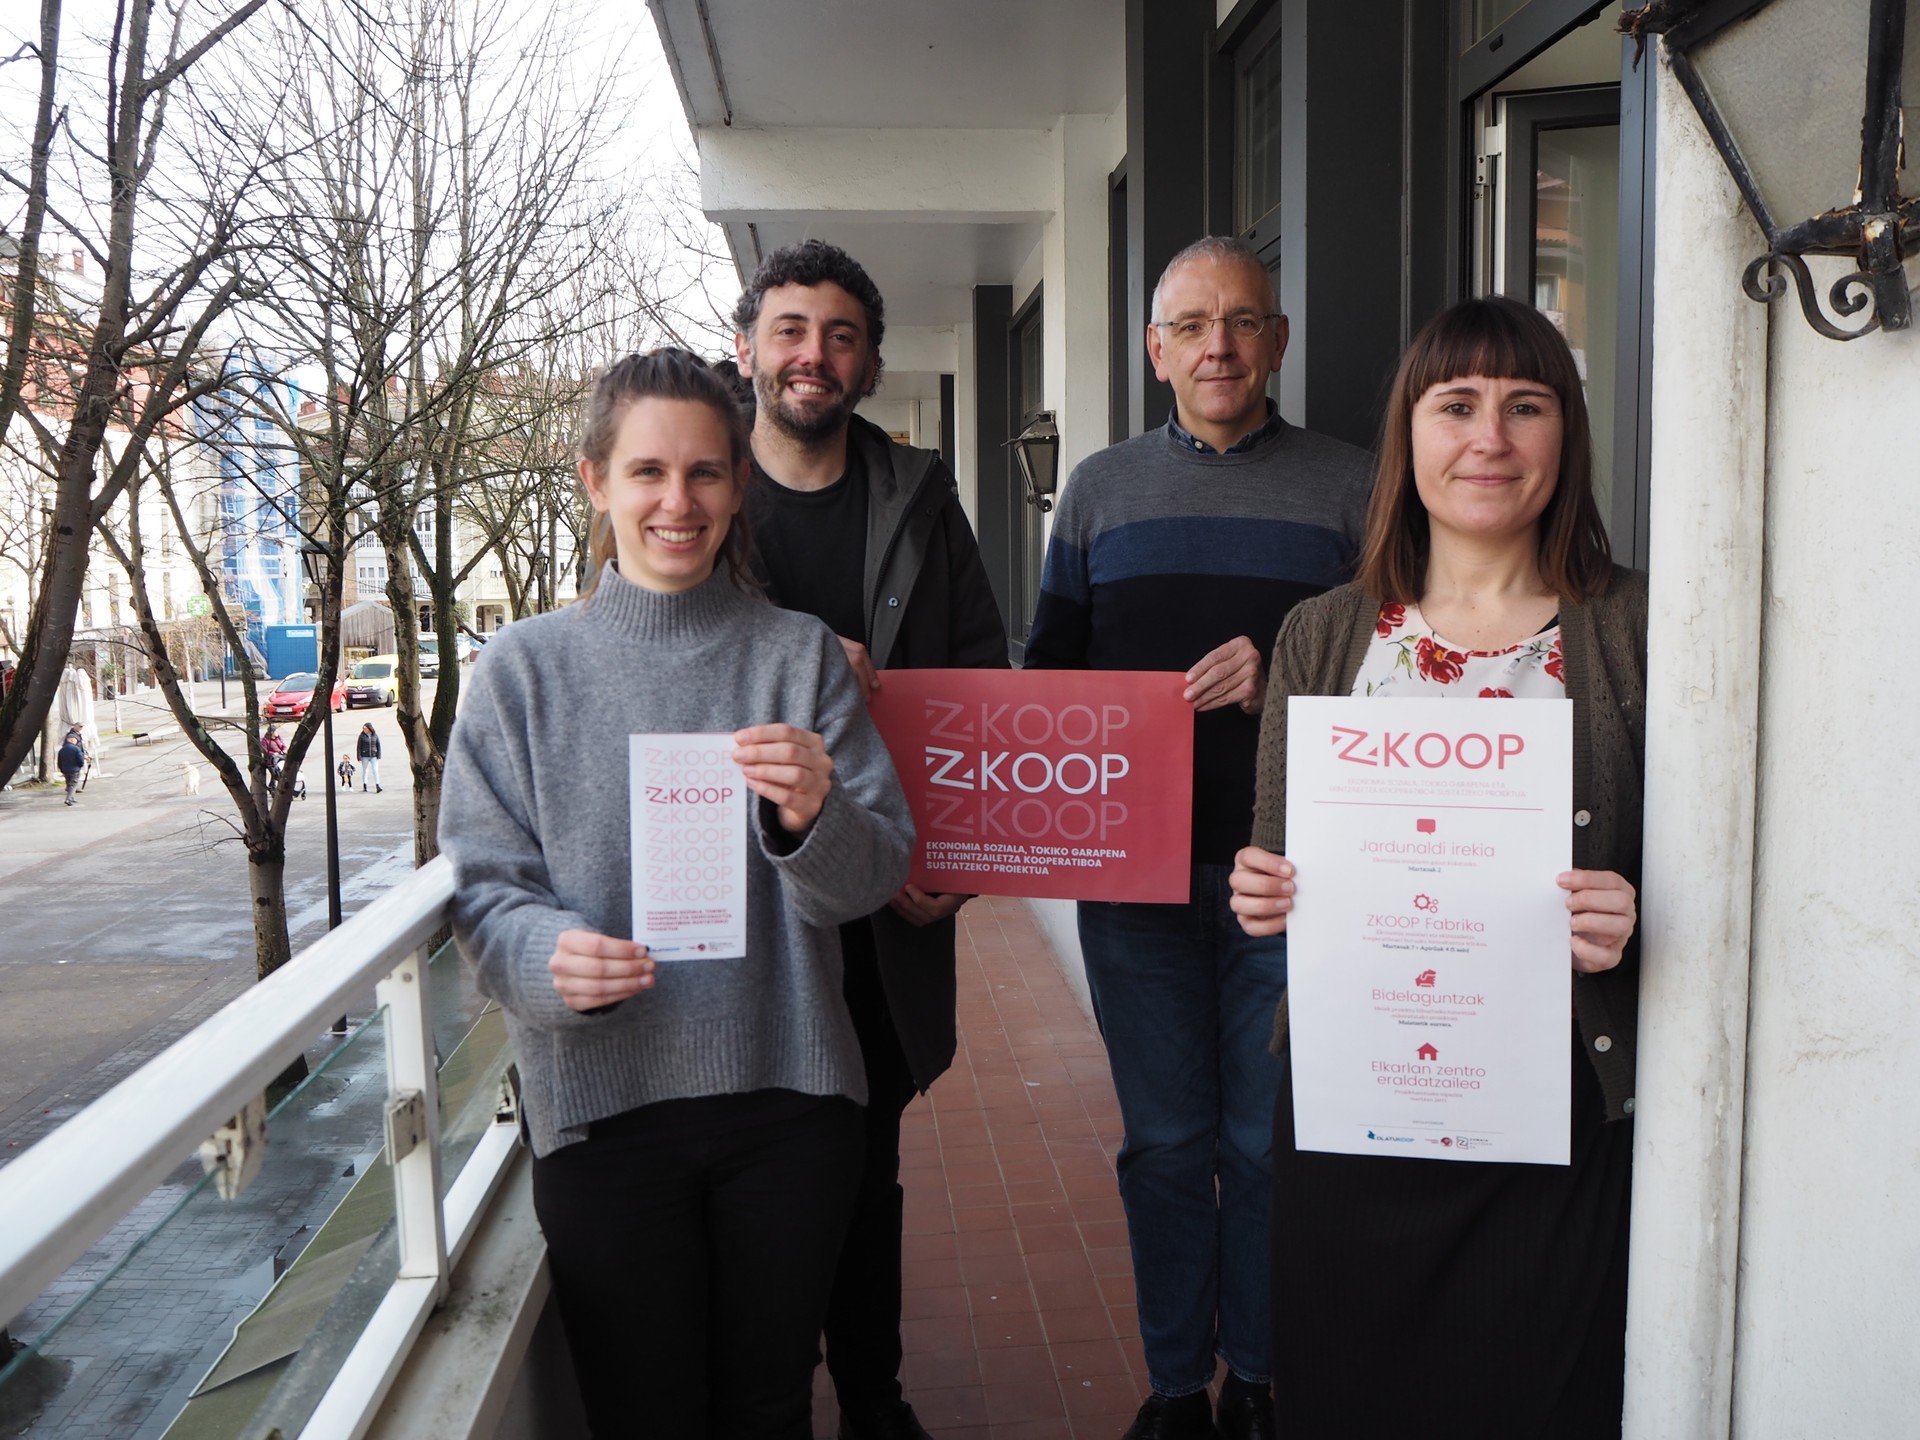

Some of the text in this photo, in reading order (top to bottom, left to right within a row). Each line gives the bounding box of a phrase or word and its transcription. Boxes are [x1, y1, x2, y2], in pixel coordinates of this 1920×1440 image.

[1332, 725, 1525, 770] ZKOOP
[925, 746, 1130, 795] ZKOOP
[926, 841, 1127, 858] EKONOMIA SOZIALA, TOKIKO GARAPENA
[1359, 840, 1495, 857] Jardunaldi irekia
[926, 851, 1102, 867] ETA EKINTZAILETZA KOOPERATIBOA
[926, 861, 1049, 875] SUSTATZEKO PROIEKTUA
[1367, 914, 1485, 932] ZKOOP Fabrika
[1372, 988, 1485, 1007] Bidelaguntzak
[1371, 1061, 1486, 1078] Elkarlan zentro
[1377, 1075, 1481, 1089] eraldatzailea
